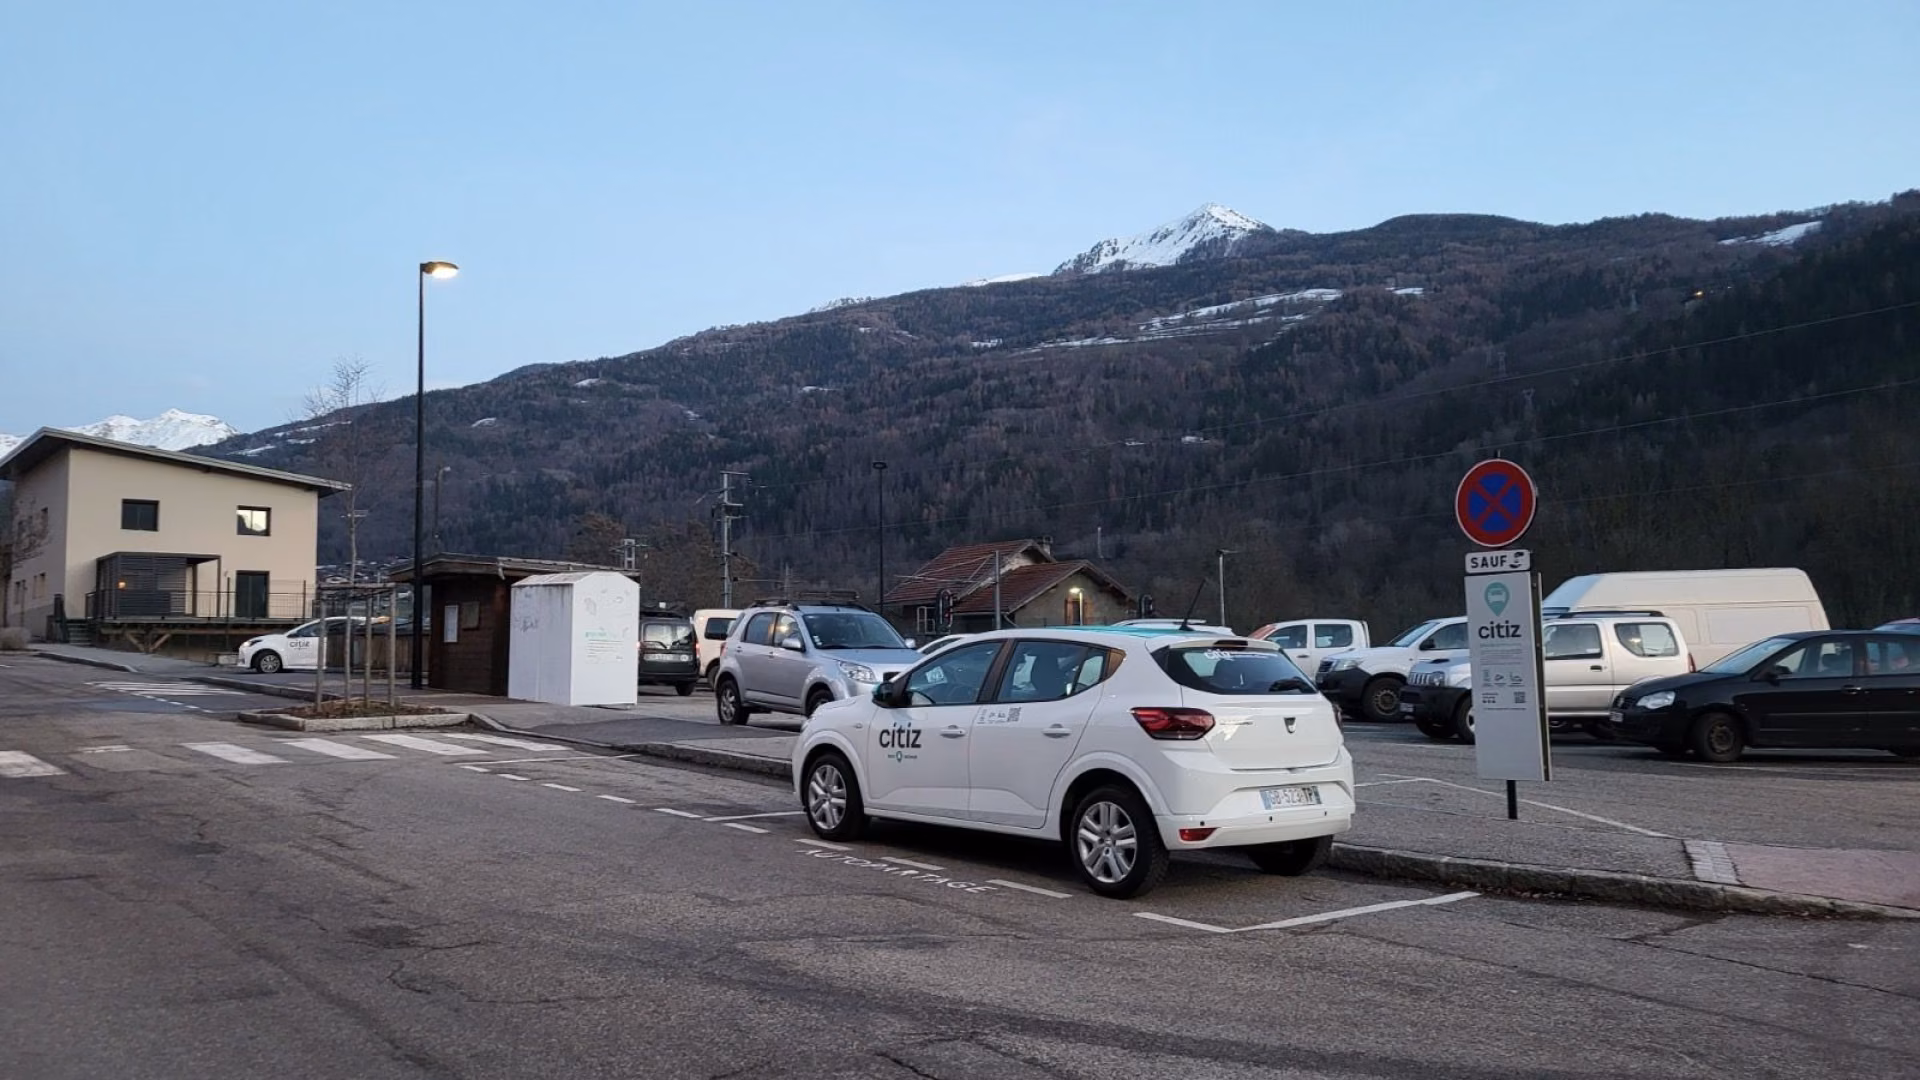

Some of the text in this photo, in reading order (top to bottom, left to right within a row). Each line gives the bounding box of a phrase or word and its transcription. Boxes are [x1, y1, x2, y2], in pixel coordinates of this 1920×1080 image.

[1471, 555, 1507, 569] SAUF
[1478, 620, 1522, 639] citiz
[879, 721, 922, 749] citiz
[796, 849, 998, 893] AUTOPARTAGE
